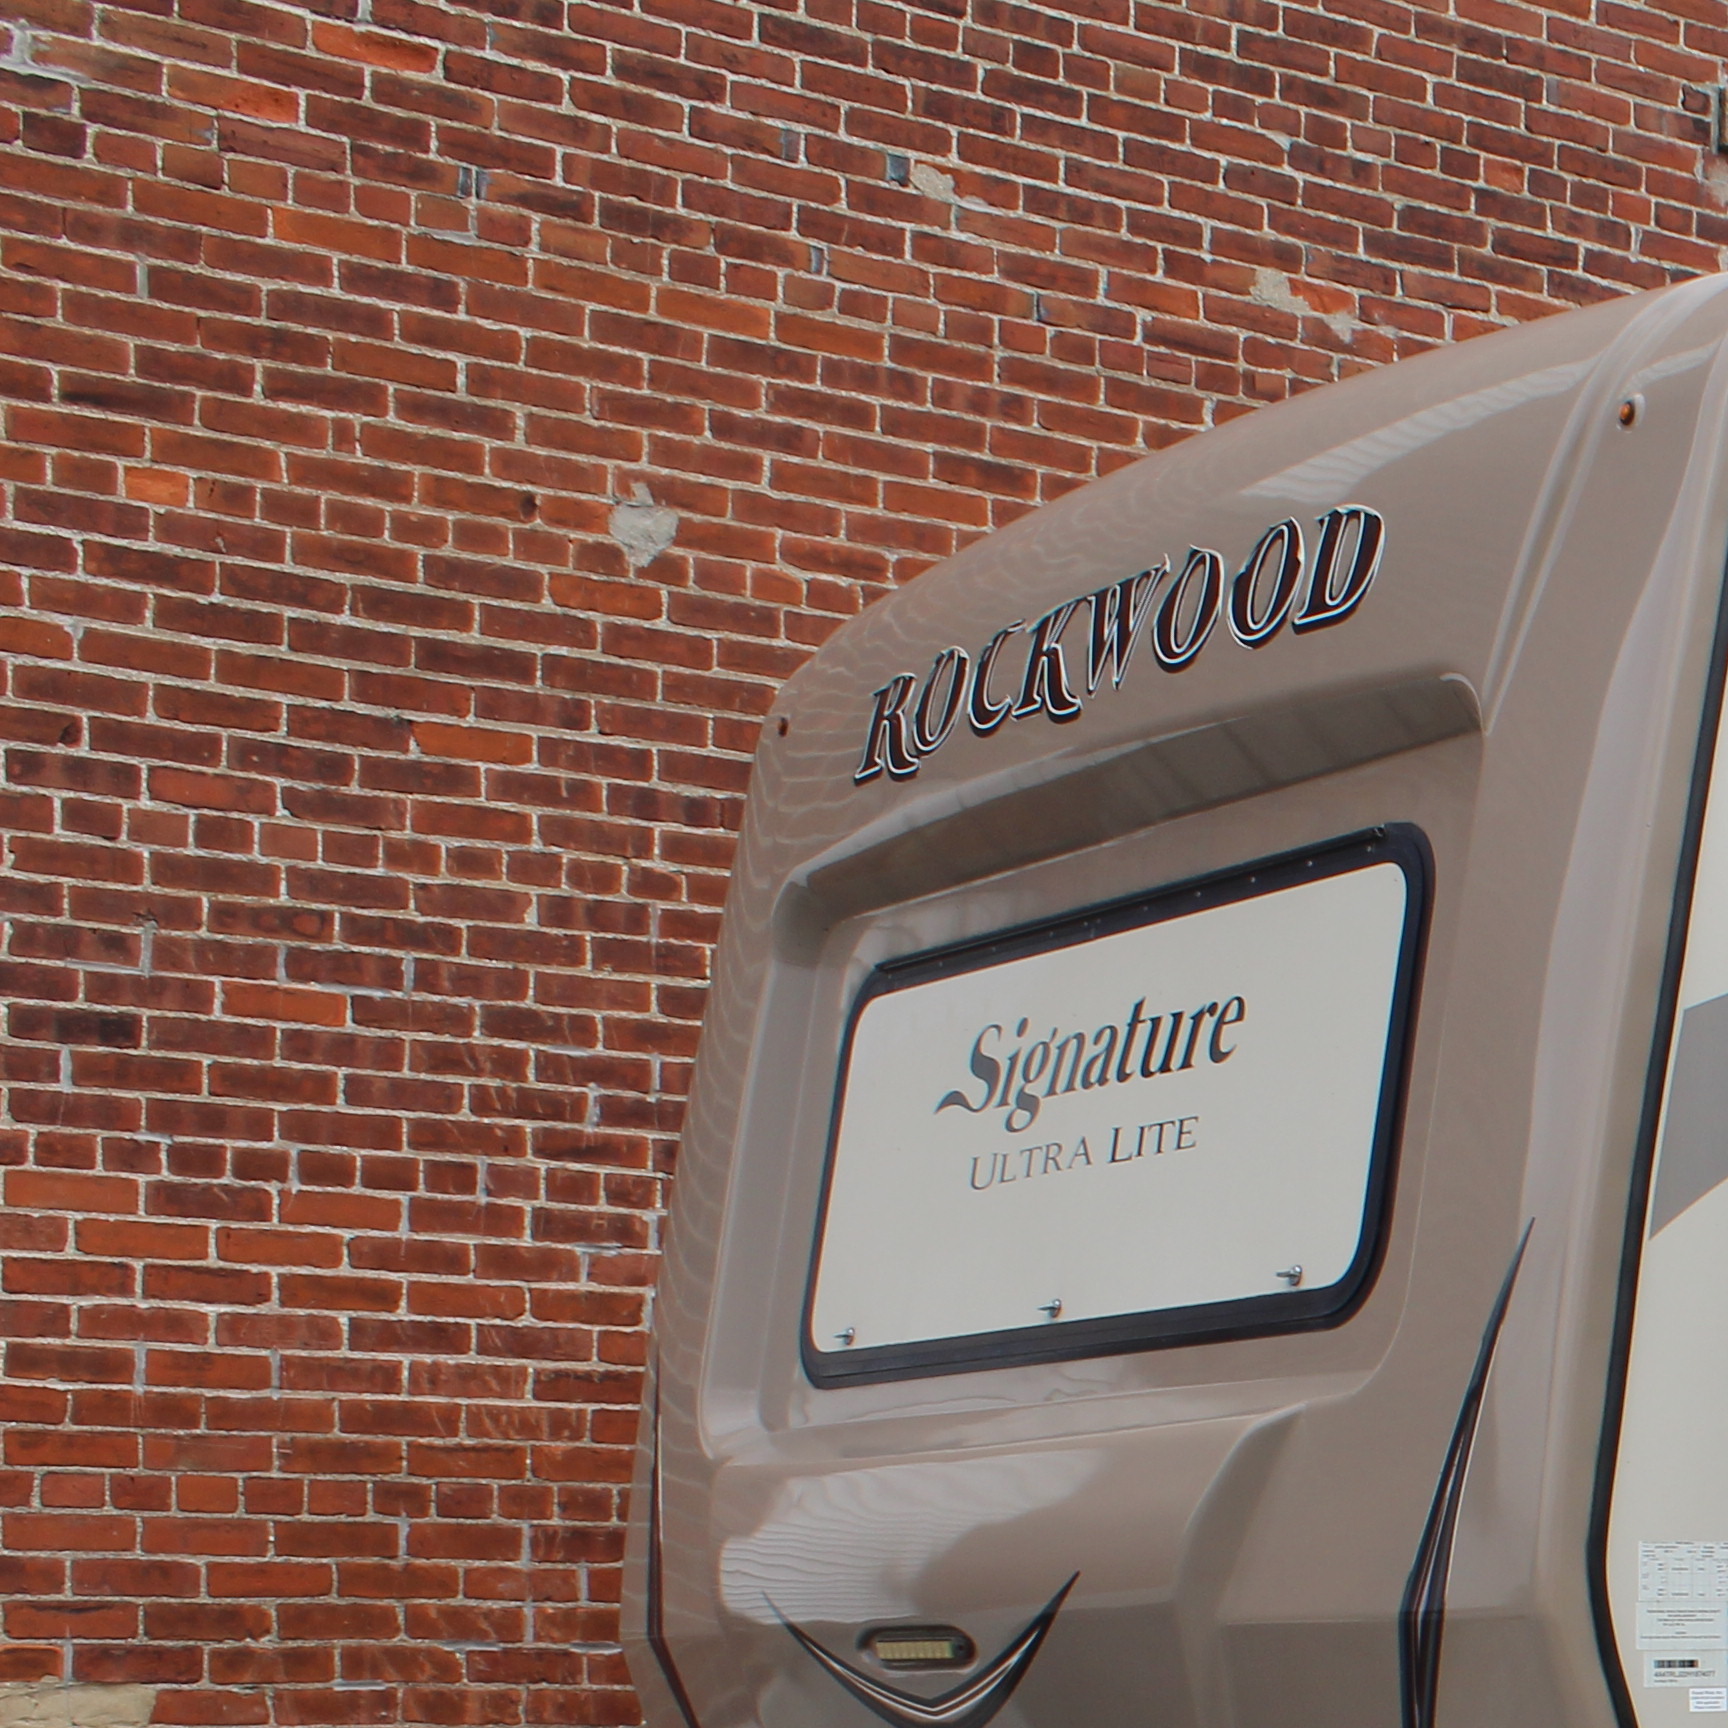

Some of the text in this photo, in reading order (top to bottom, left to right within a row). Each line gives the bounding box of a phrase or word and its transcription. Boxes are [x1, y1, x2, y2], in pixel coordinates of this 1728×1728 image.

[853, 503, 1386, 784] ROCKWOOD
[934, 994, 1247, 1134] Signature
[968, 1114, 1201, 1191] ULTRA LITE
